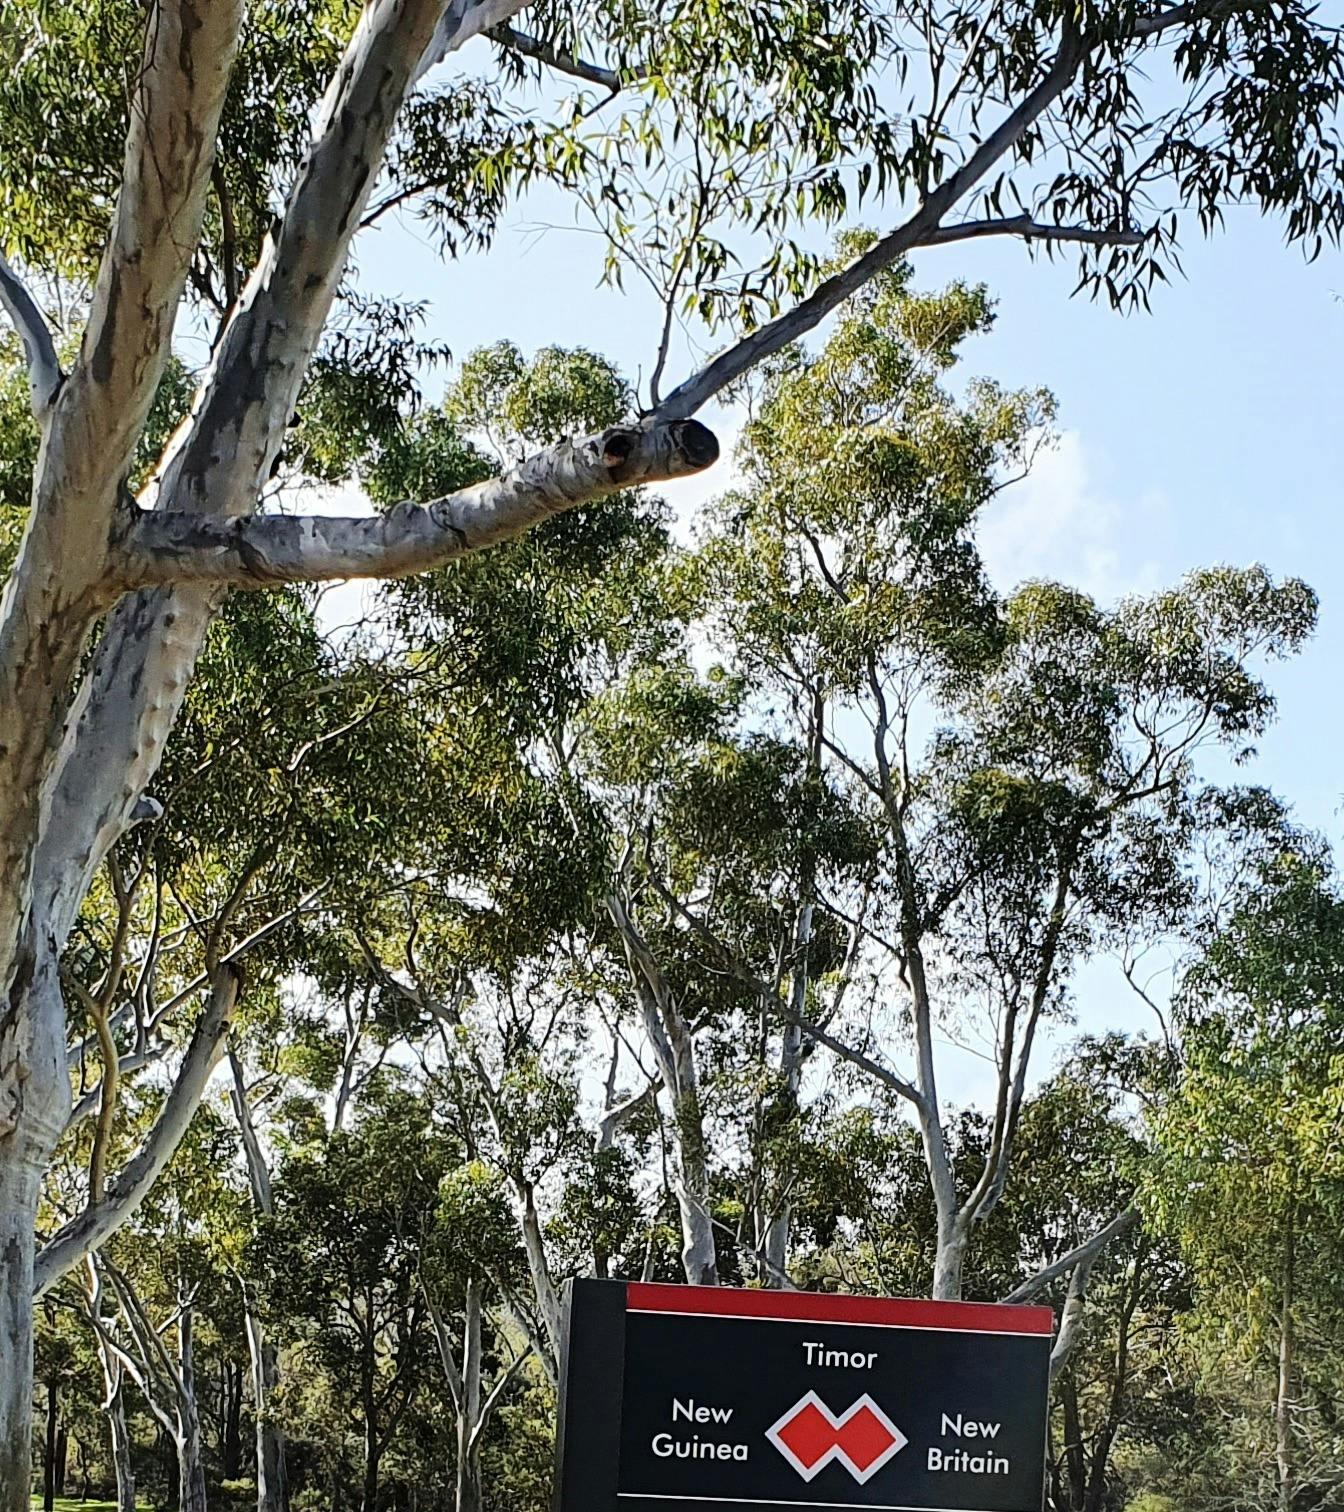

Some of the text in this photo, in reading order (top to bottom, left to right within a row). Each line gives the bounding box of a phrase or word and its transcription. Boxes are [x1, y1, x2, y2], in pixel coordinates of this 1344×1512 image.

[802, 1341, 878, 1369] Timor
[672, 1397, 734, 1424] New
[940, 1412, 1001, 1439] New
[651, 1432, 749, 1461] Guinea
[927, 1447, 1009, 1475] Britain
